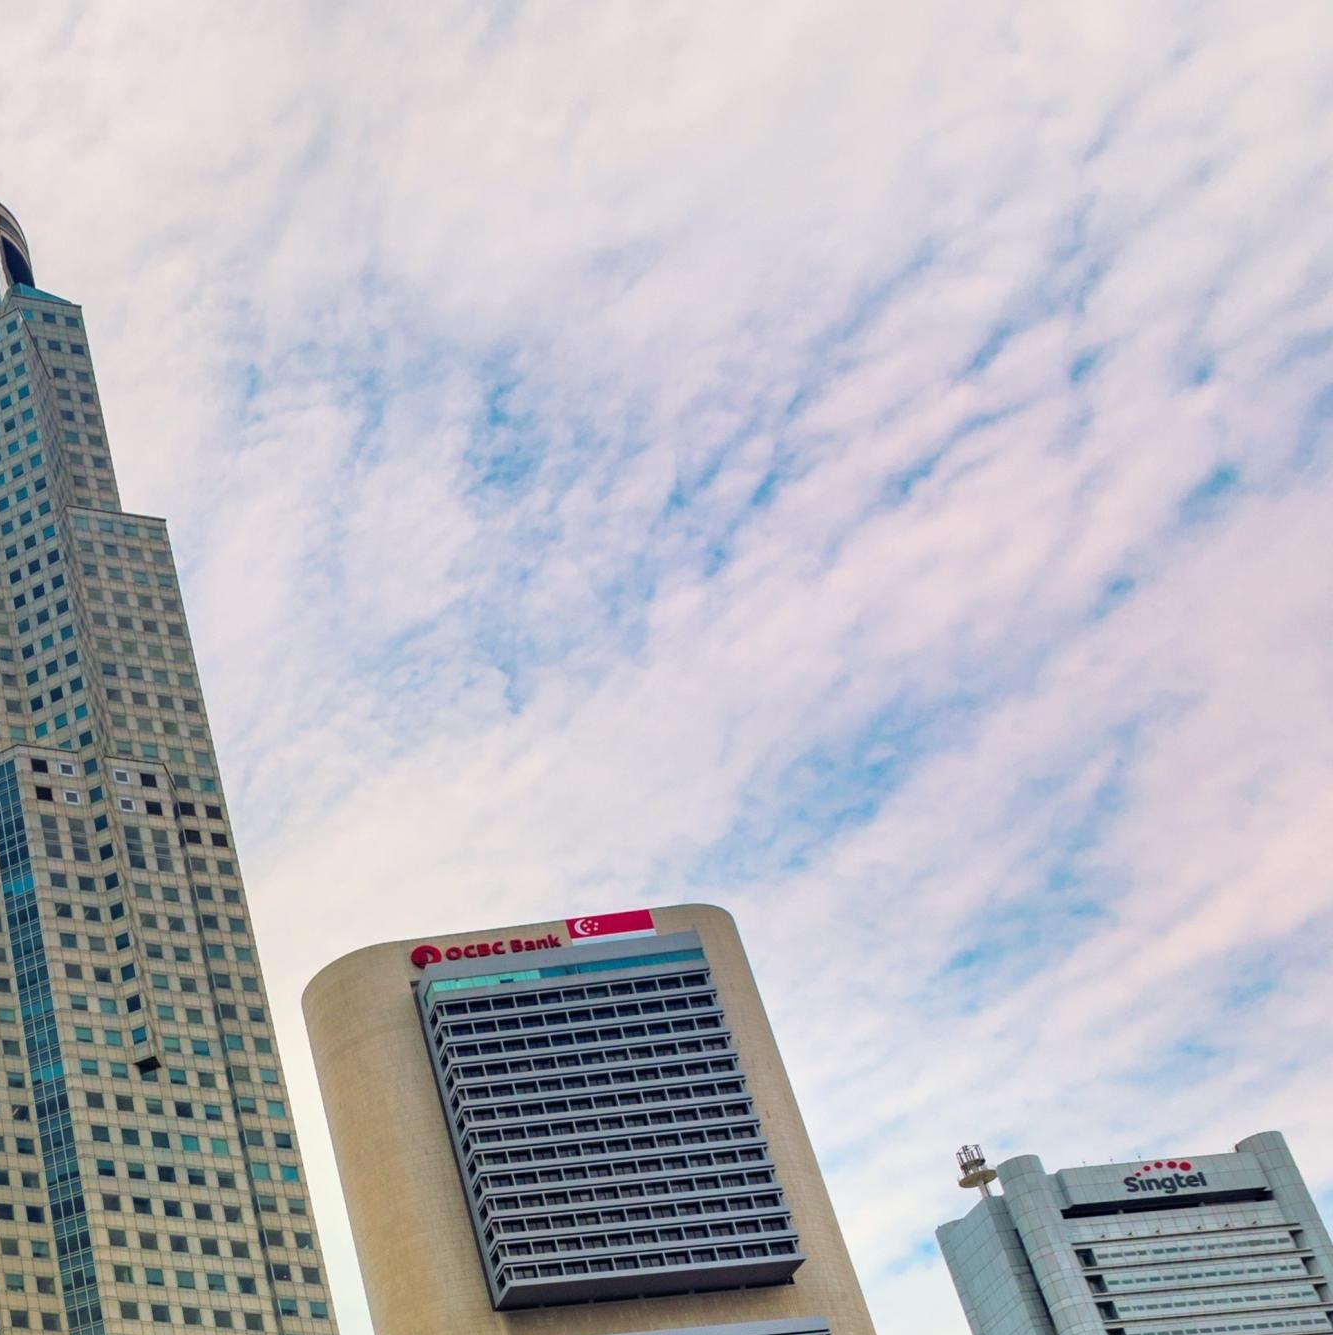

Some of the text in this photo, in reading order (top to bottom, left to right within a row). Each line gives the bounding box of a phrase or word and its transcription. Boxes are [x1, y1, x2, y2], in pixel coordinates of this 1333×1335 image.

[445, 934, 562, 961] OCBC Bank
[1124, 1171, 1208, 1194] Singtel
